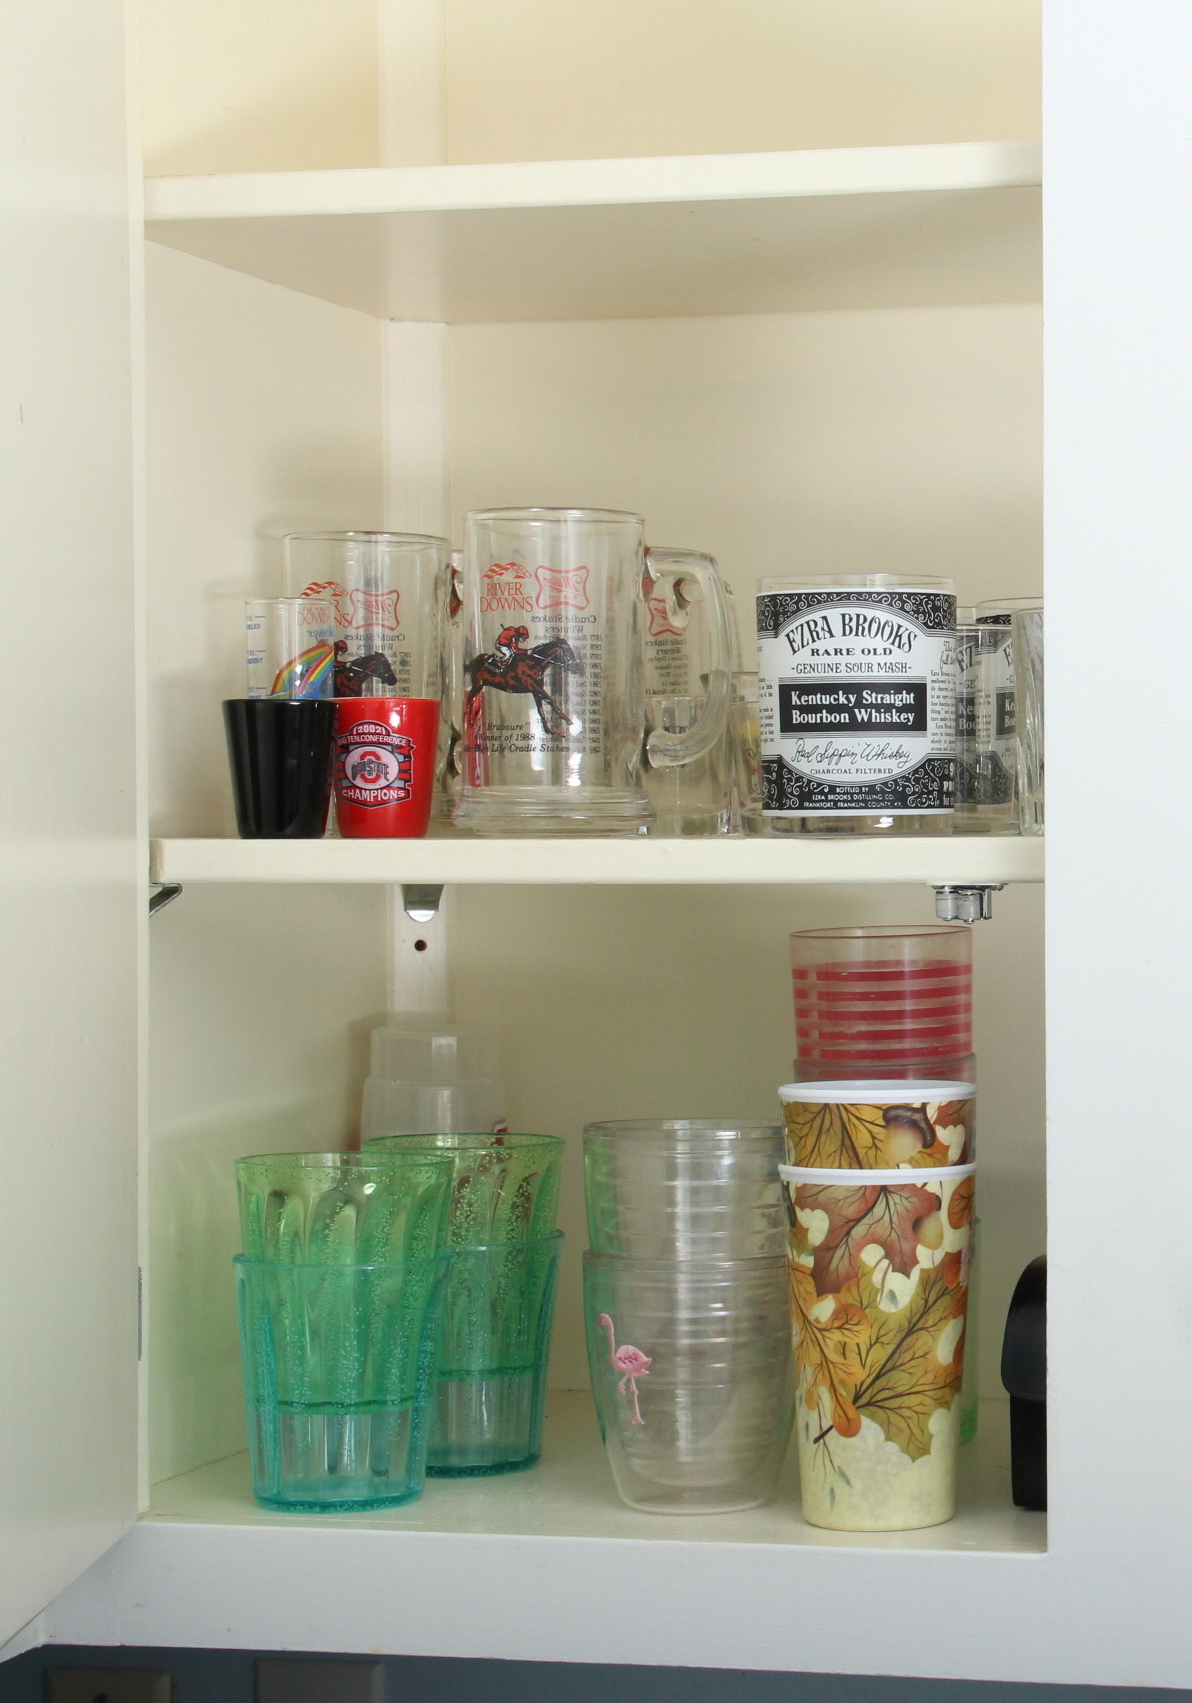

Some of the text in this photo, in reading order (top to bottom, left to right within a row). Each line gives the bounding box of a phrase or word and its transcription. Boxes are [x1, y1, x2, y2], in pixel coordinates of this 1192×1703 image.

[486, 582, 523, 597] RIVER
[480, 596, 534, 613] DOWNS
[784, 615, 836, 656] EZRA
[840, 613, 918, 654] BROOKS
[810, 647, 893, 657] RARE OLD
[845, 662, 873, 674] SOUR
[790, 689, 915, 707] Kentucky Straight
[791, 708, 915, 725] Bourbon Whiskey
[353, 725, 386, 735] (2002)
[360, 735, 407, 746] CONFERENCE
[504, 733, 513, 743] of
[515, 733, 536, 741] 1988
[491, 744, 506, 753] Life
[509, 743, 537, 753] Cradle
[539, 743, 570, 753] Stakes
[791, 738, 819, 763] Real
[860, 741, 913, 768] Whiskey
[855, 767, 894, 775] FILTERED
[342, 789, 405, 802] CHAMPIONS
